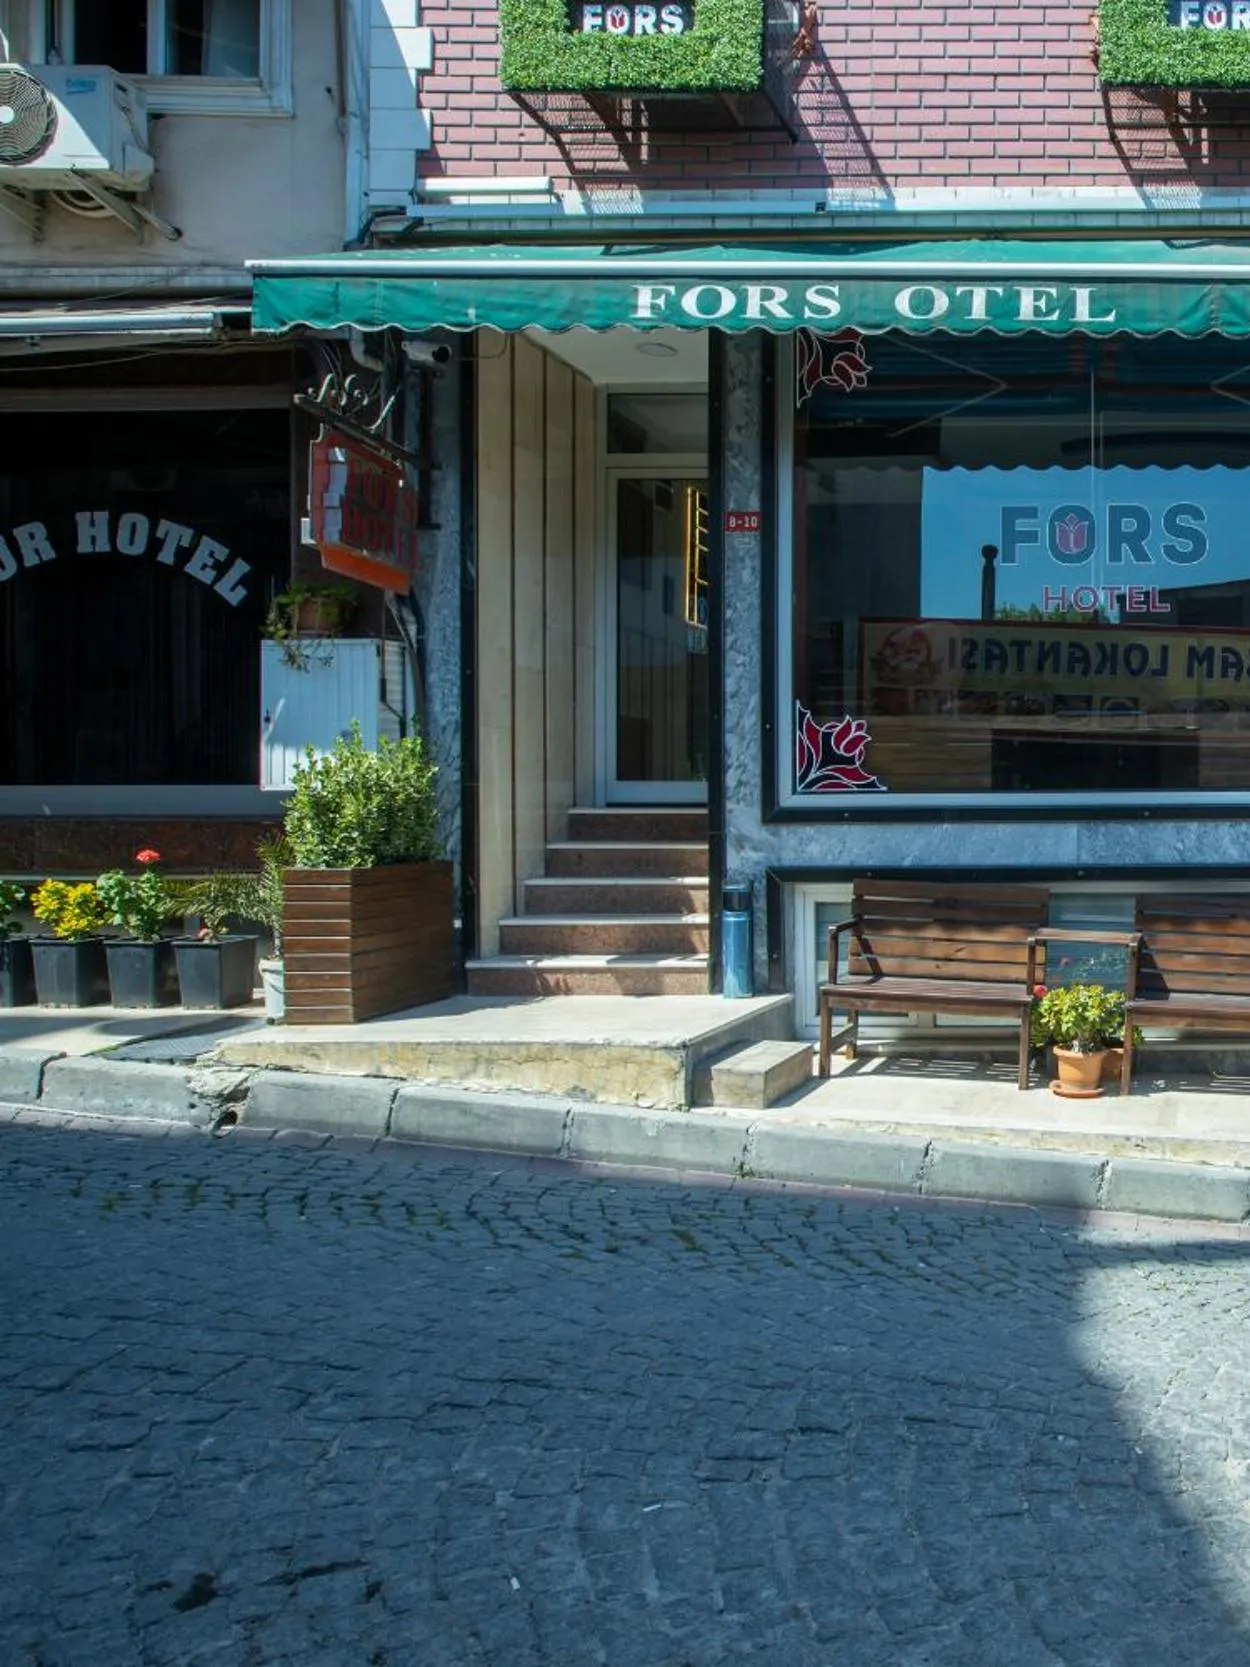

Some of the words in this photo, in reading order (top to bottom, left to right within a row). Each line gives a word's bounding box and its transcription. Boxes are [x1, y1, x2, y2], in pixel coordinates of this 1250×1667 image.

[583, 4, 684, 36] FORS
[629, 284, 842, 319] FORS
[894, 285, 1117, 322] OTEL
[999, 502, 1208, 566] FORS
[75, 510, 252, 607] HOTEL
[1042, 584, 1171, 614] HOTEL
